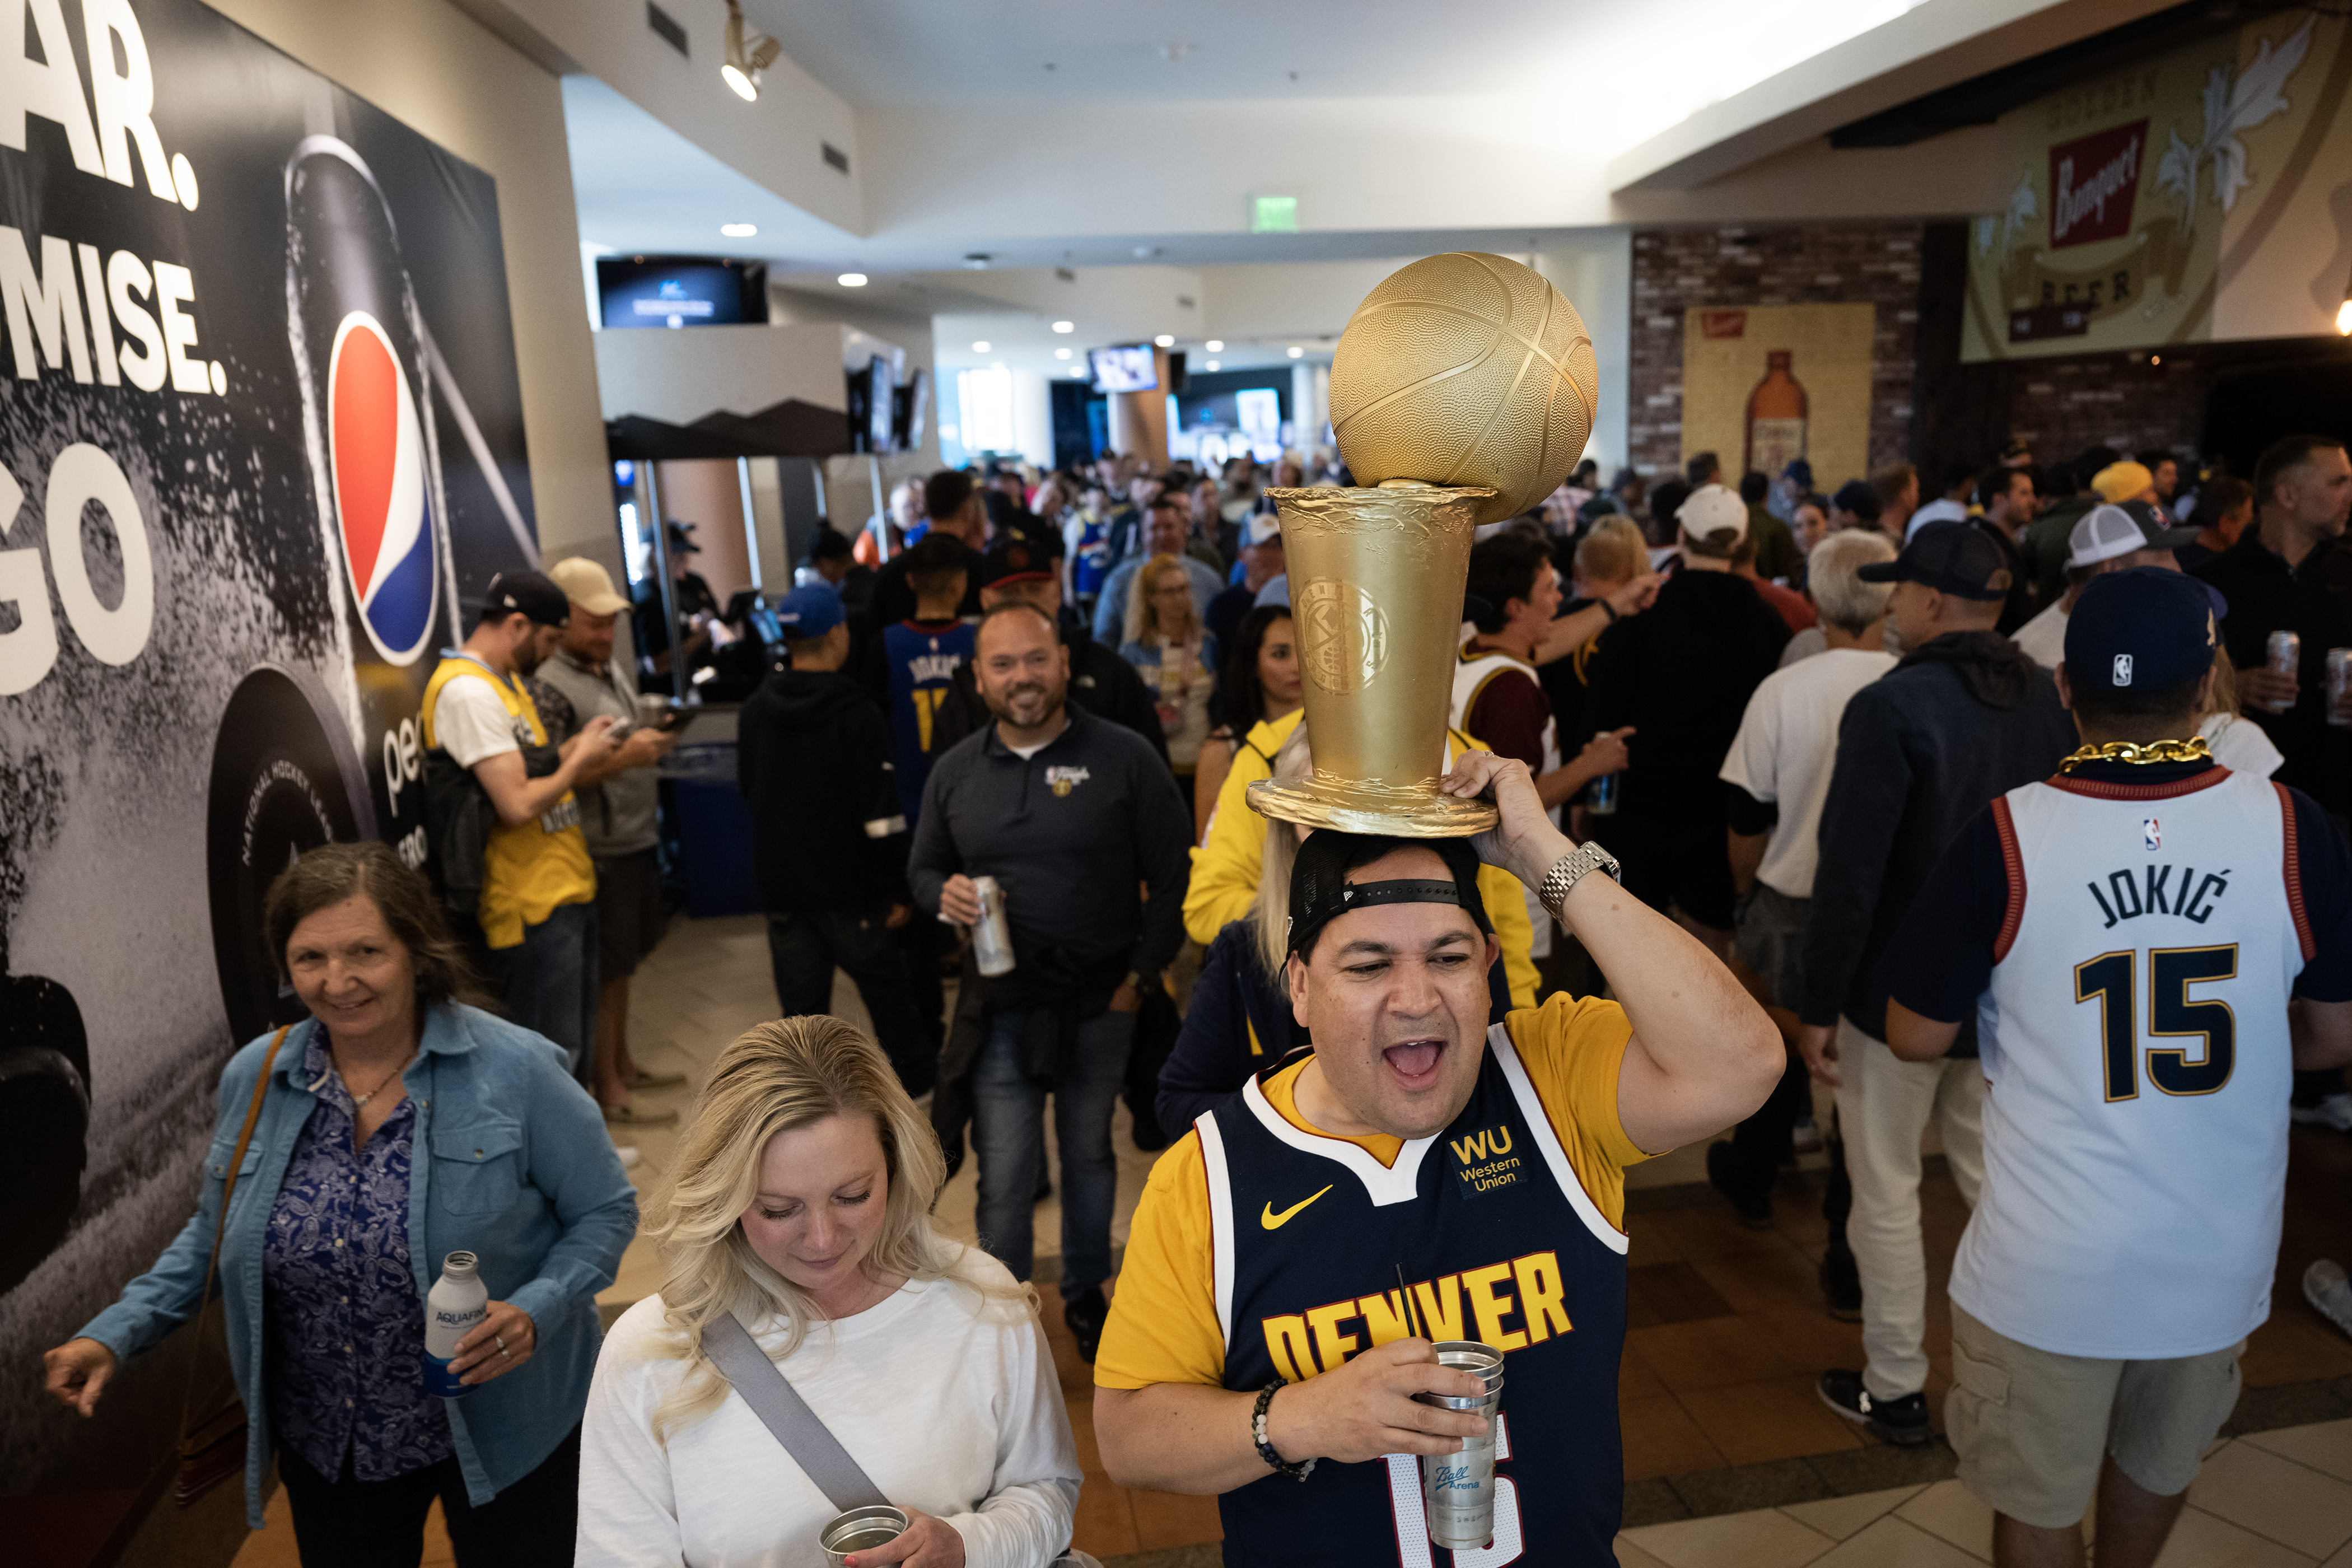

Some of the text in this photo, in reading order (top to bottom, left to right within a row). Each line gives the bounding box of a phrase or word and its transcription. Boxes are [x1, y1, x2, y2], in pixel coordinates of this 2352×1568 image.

[2088, 865, 2232, 929] JOKIĆ
[2074, 942, 2238, 1103] 15
[1450, 1126, 1512, 1165] WU
[1460, 1158, 1520, 1182] Western
[1474, 1173, 1516, 1192] Union
[1435, 1466, 1470, 1483] Ball
[1449, 1480, 1480, 1490] Arena
